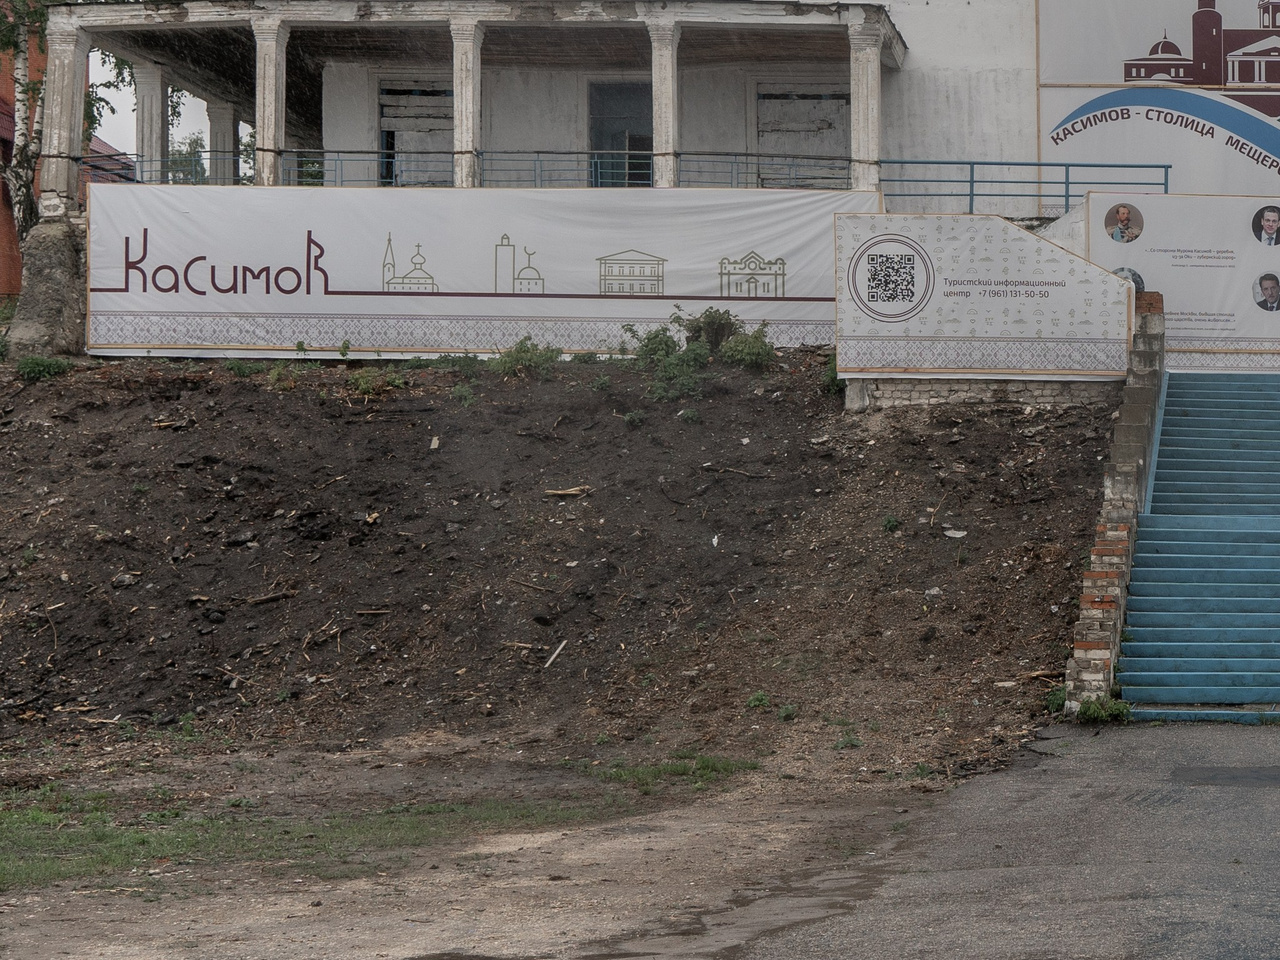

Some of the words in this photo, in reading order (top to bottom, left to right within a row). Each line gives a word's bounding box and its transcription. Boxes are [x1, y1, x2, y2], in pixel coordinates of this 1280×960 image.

[1050, 108, 1131, 146] КАСИМОВ
[1145, 109, 1215, 139] СТОЛИЦА
[943, 278, 992, 288] Туристский
[993, 279, 1067, 288] информационный
[943, 290, 972, 298] центр
[978, 289, 987, 298] +7
[988, 289, 1008, 298] (961)
[1009, 289, 1050, 299] 131-50-50
